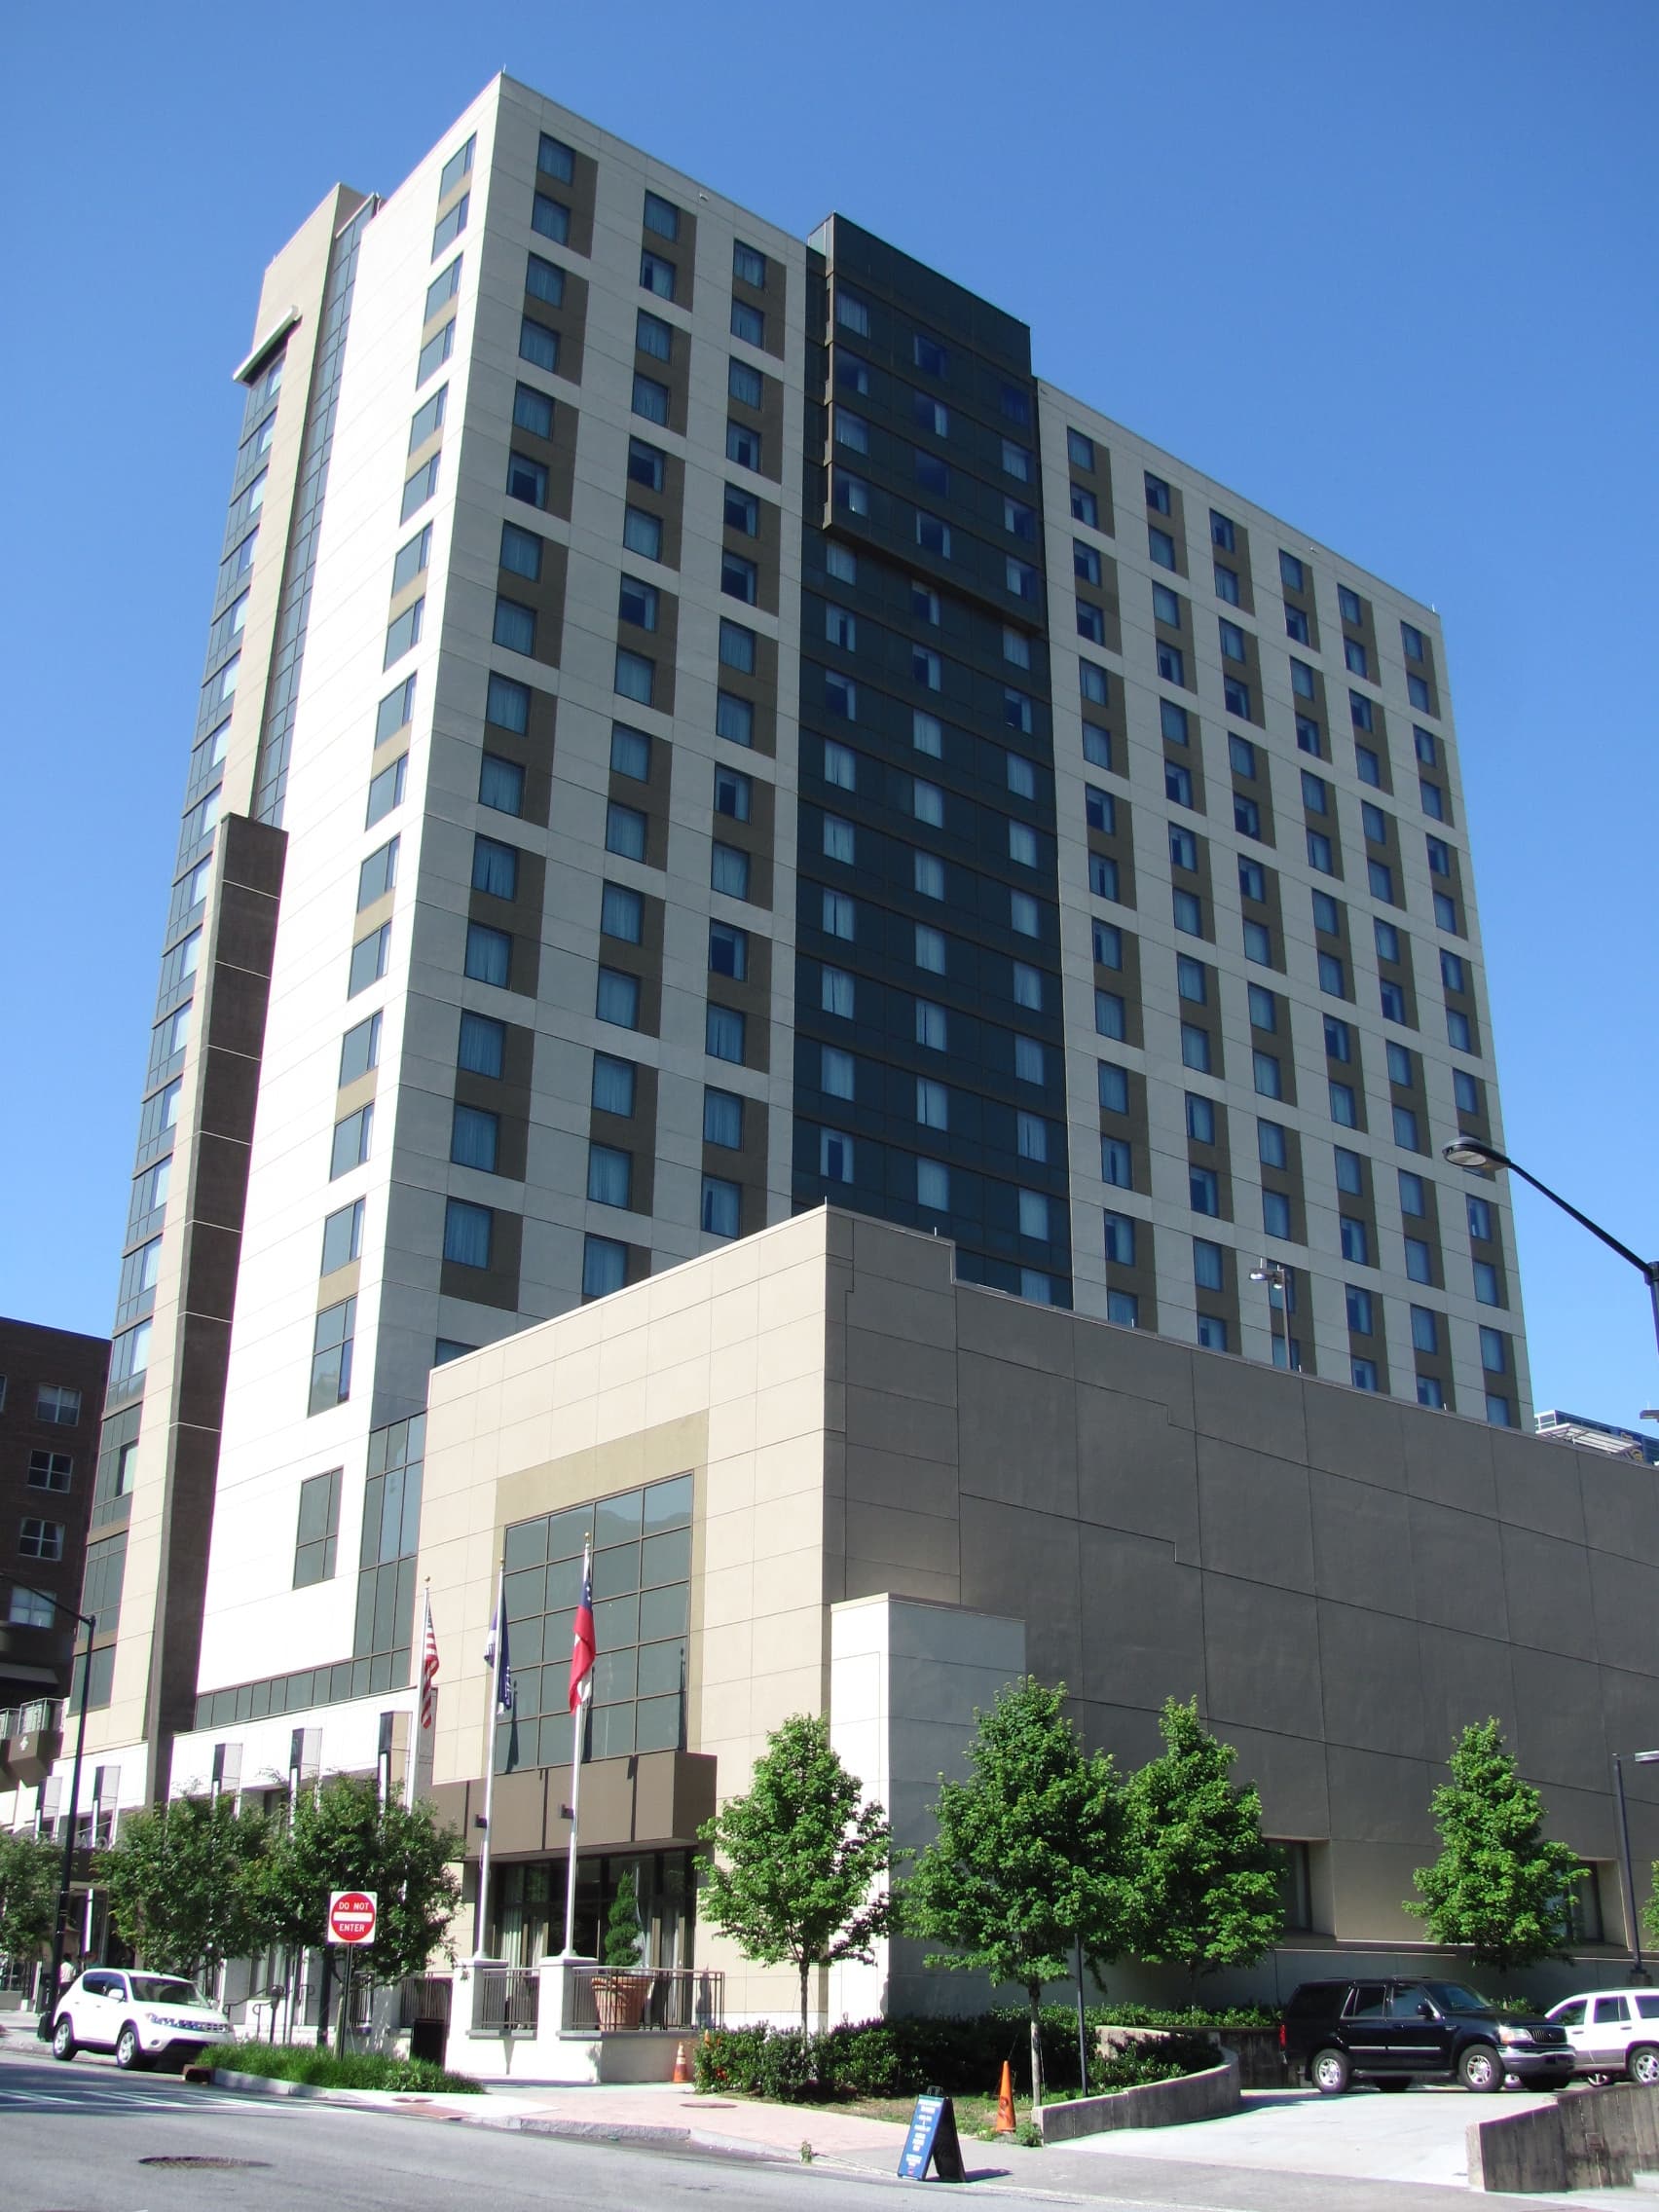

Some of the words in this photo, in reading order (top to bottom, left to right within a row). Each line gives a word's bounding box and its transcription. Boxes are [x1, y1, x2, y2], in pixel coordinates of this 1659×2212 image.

[339, 1901, 350, 1910] DO
[353, 1901, 369, 1910] NOT
[339, 1923, 365, 1933] ENTER
